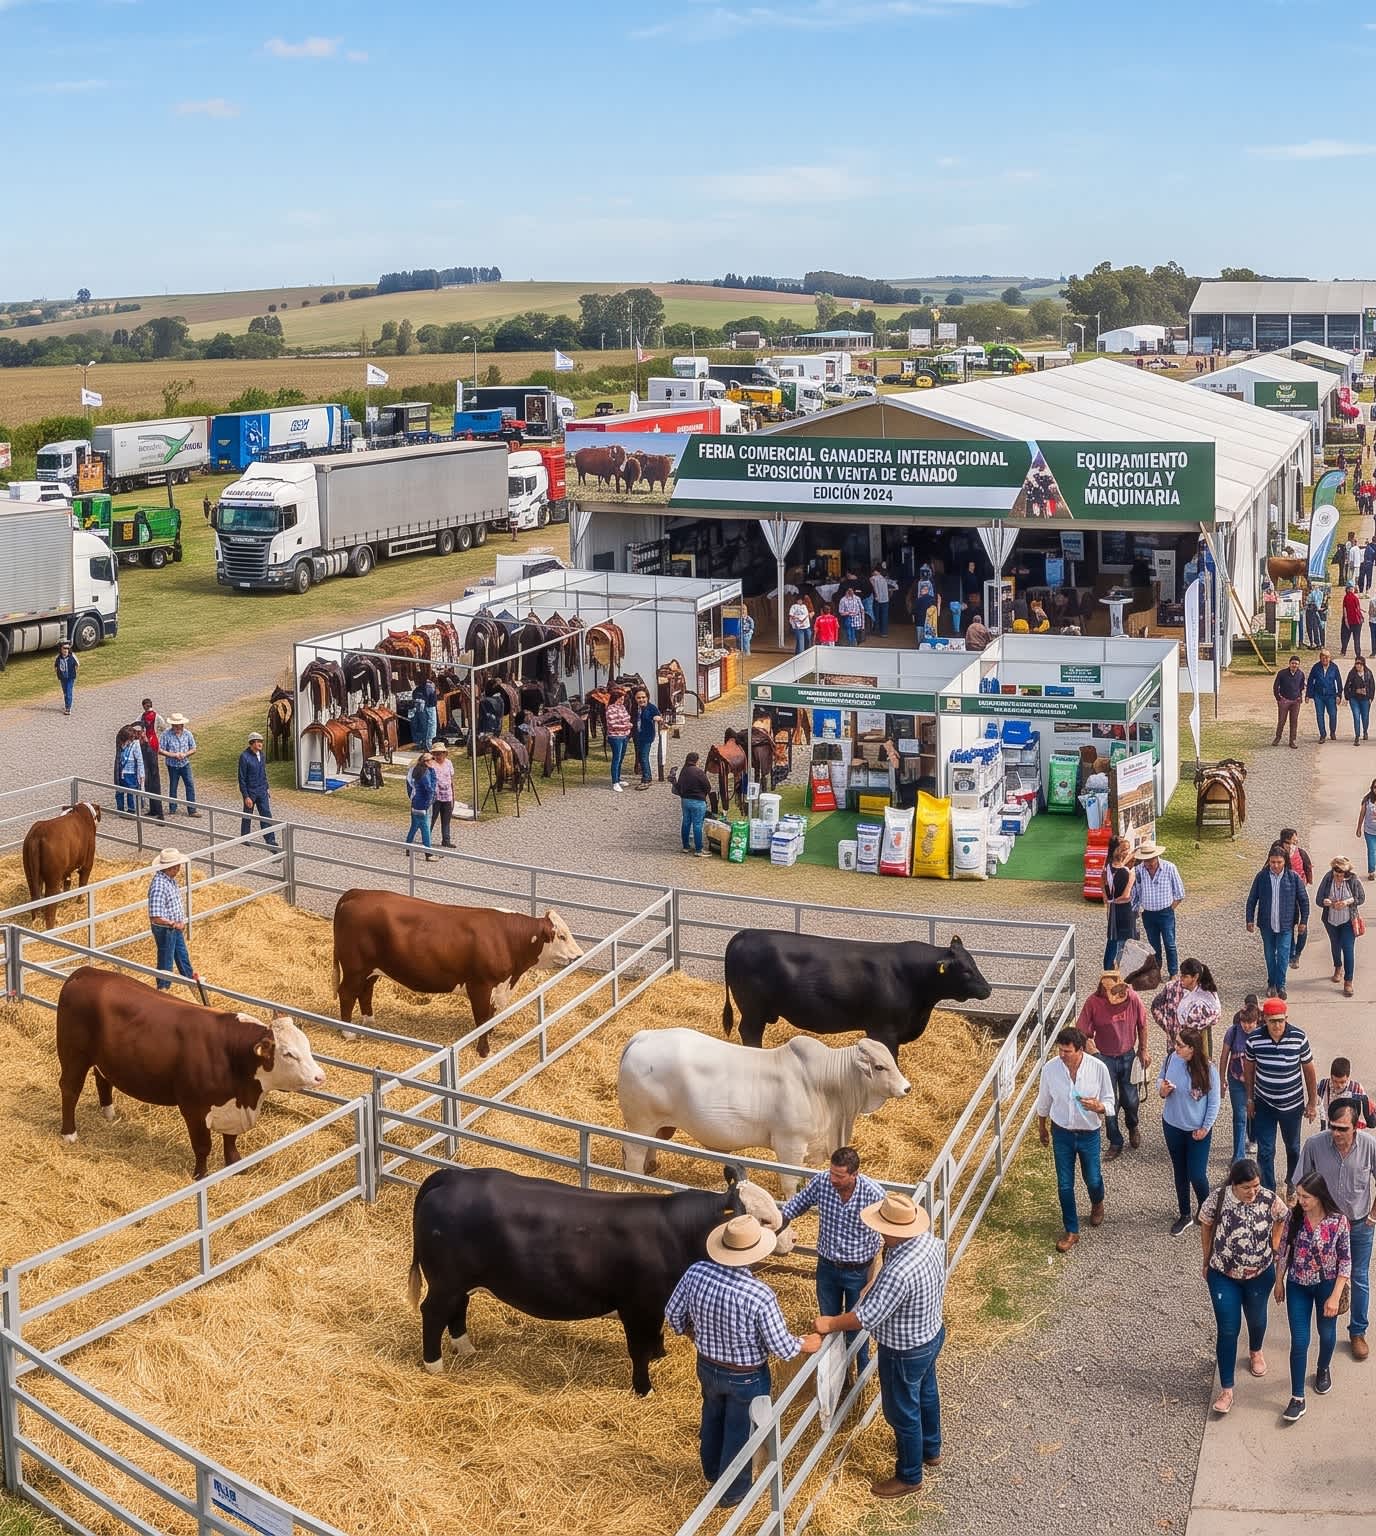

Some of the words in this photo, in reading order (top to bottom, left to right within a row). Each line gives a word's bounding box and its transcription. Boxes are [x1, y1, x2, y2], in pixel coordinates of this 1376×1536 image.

[699, 443, 736, 459] FERIA
[739, 445, 816, 462] COMERCIAL
[819, 448, 893, 464] GANADERA
[897, 449, 1009, 466] INTERNACIONAL
[1076, 452, 1188, 470] EQUIPAMIENTO
[747, 462, 822, 480] EXPOSICIÓN
[826, 466, 834, 480] Y
[836, 466, 878, 481] VENTA
[881, 468, 897, 481] DE
[900, 467, 958, 483] GANADO
[1087, 468, 1162, 487] AGRÍCOLA
[1164, 471, 1176, 486] Y
[813, 485, 860, 500] EDICIÓN
[863, 487, 893, 501] 2024
[1084, 488, 1181, 507] MAQUINARIA
